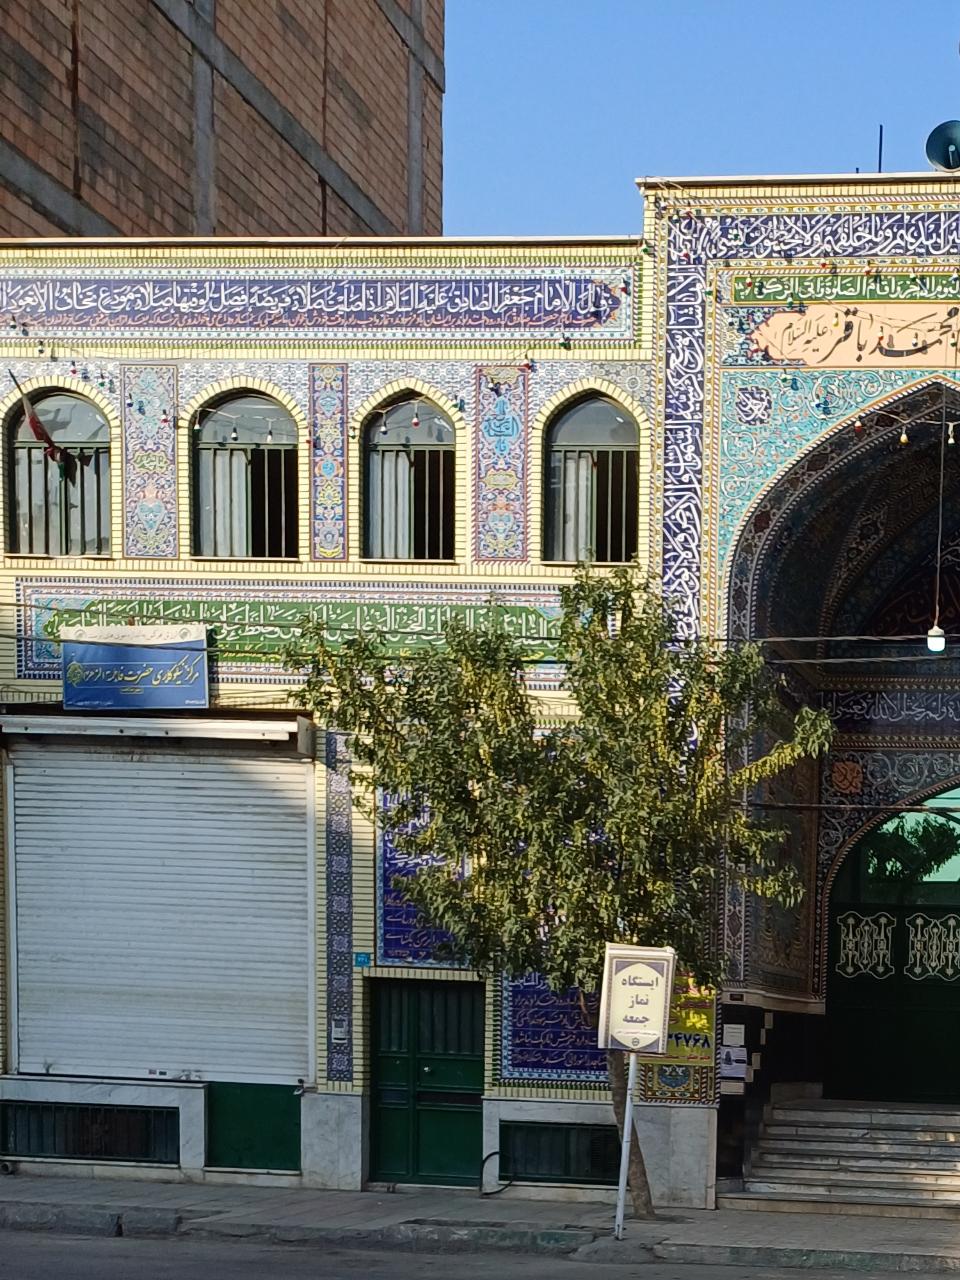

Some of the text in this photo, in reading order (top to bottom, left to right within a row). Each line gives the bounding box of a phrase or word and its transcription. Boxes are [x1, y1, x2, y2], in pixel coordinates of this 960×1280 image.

[816, 307, 873, 364] باقر
[869, 307, 960, 358] محمد
[621, 975, 659, 991] ایستگاه
[629, 993, 649, 1008] نماز
[622, 1014, 650, 1027] جمعه
